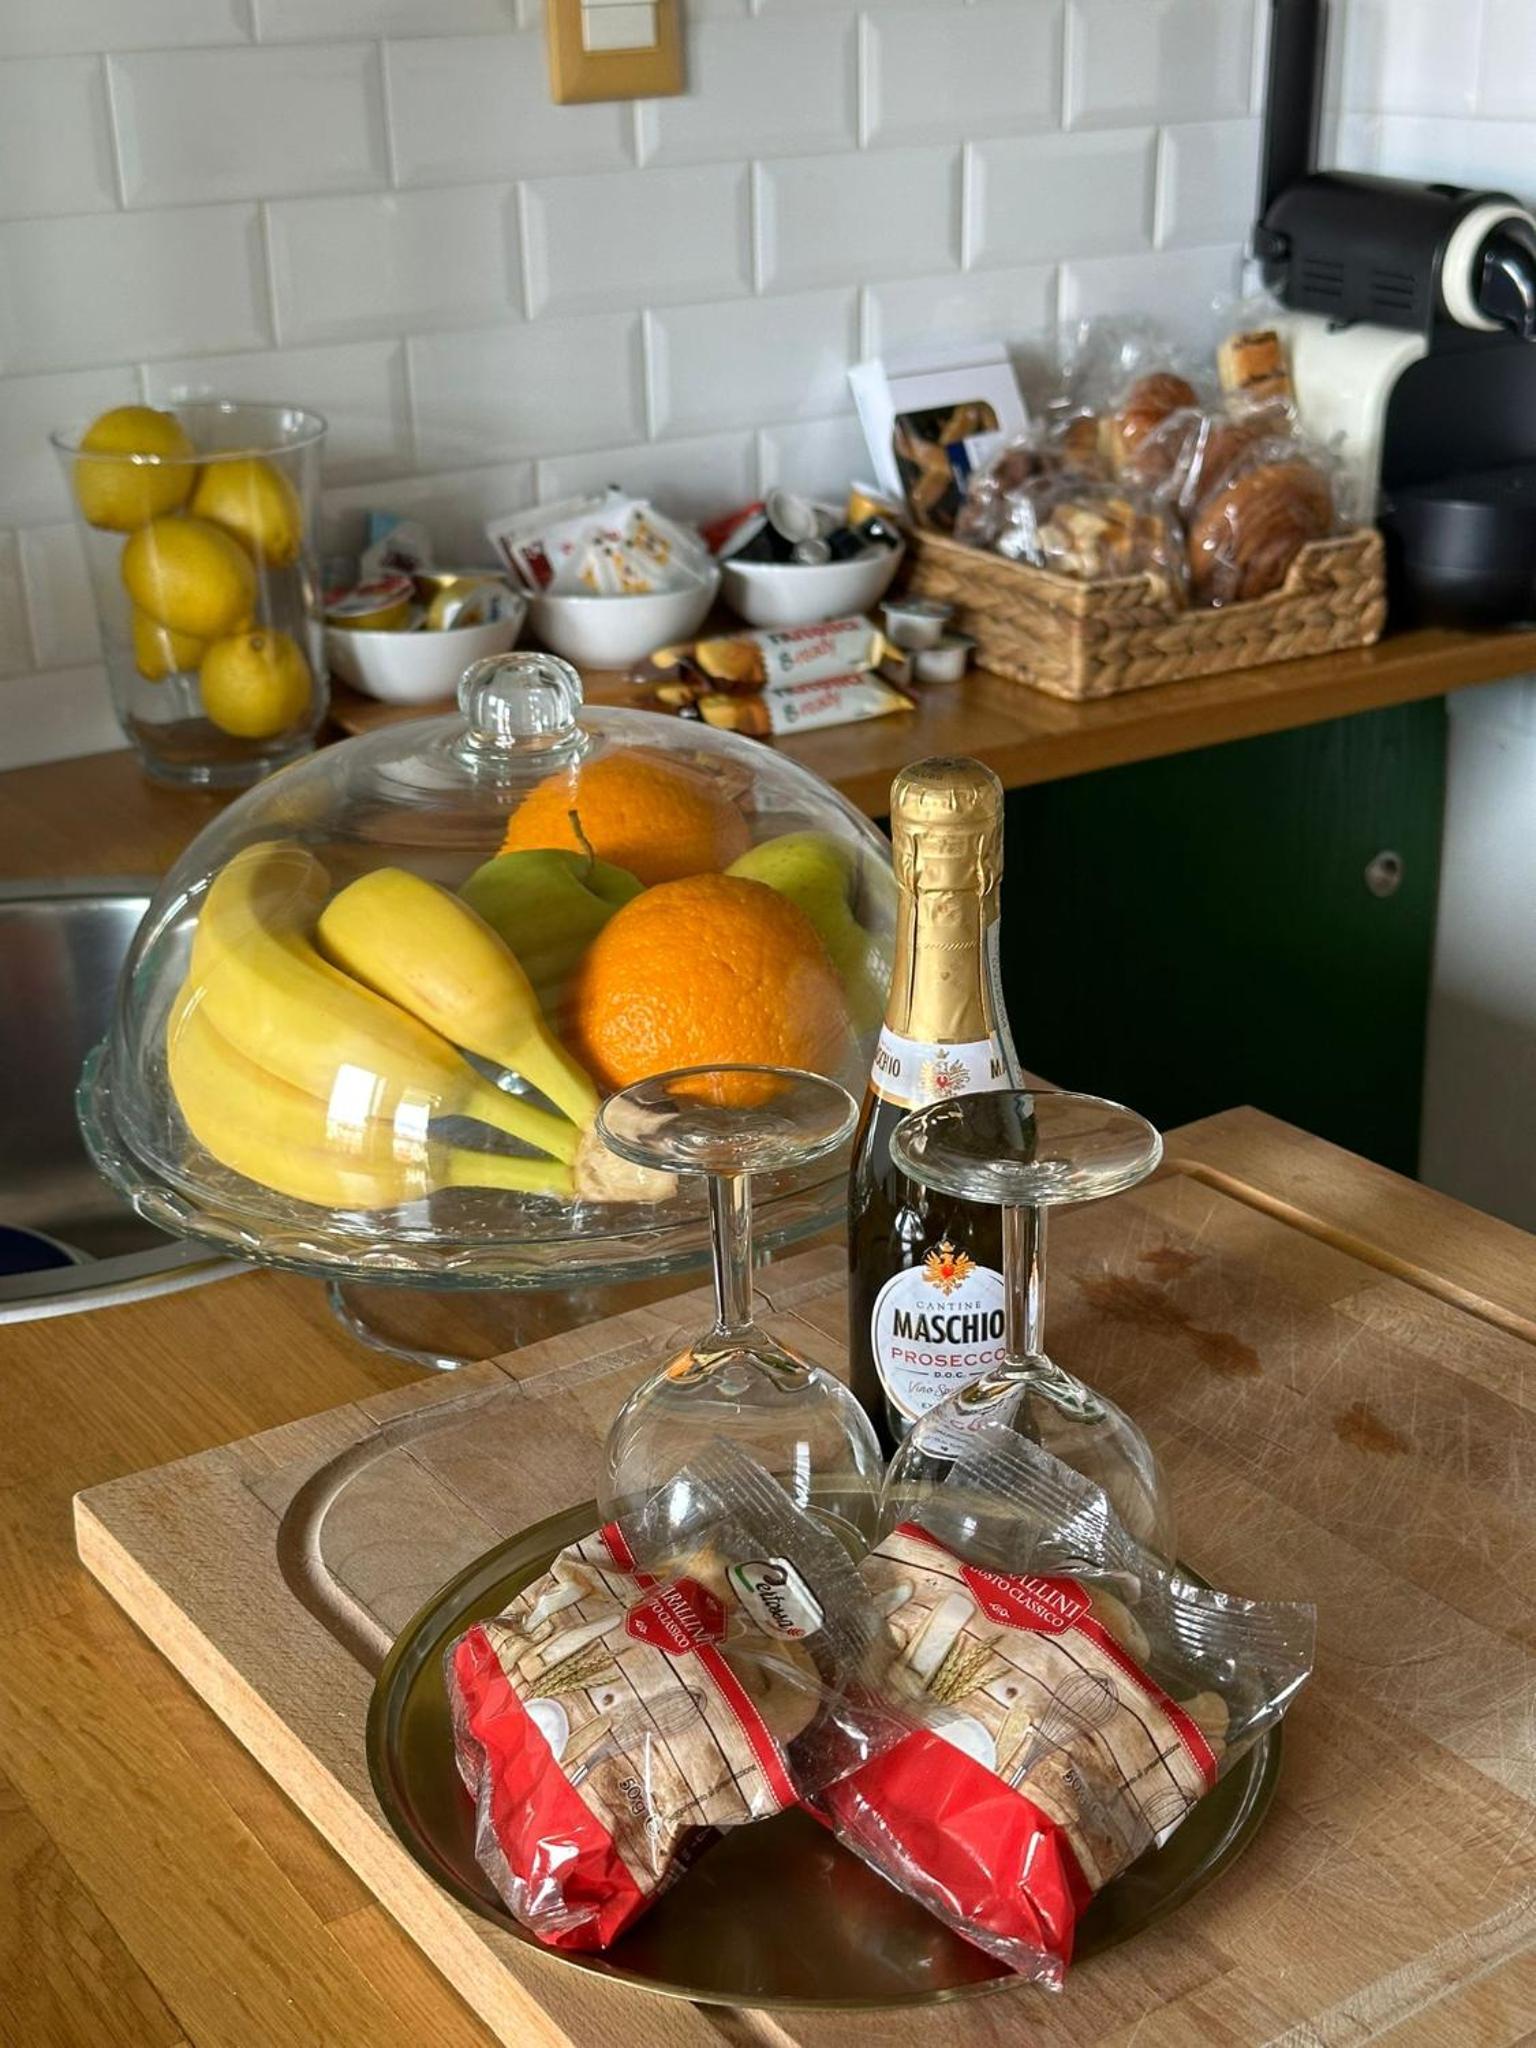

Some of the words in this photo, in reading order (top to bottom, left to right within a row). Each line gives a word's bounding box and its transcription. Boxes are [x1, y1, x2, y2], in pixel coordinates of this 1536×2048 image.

[916, 1301, 981, 1311] CANTINE
[893, 1308, 1005, 1345] MASCHIO
[891, 1347, 1006, 1368] PROSECCO
[908, 1380, 934, 1395] Vino
[1009, 1587, 1064, 1627] CLASSICO
